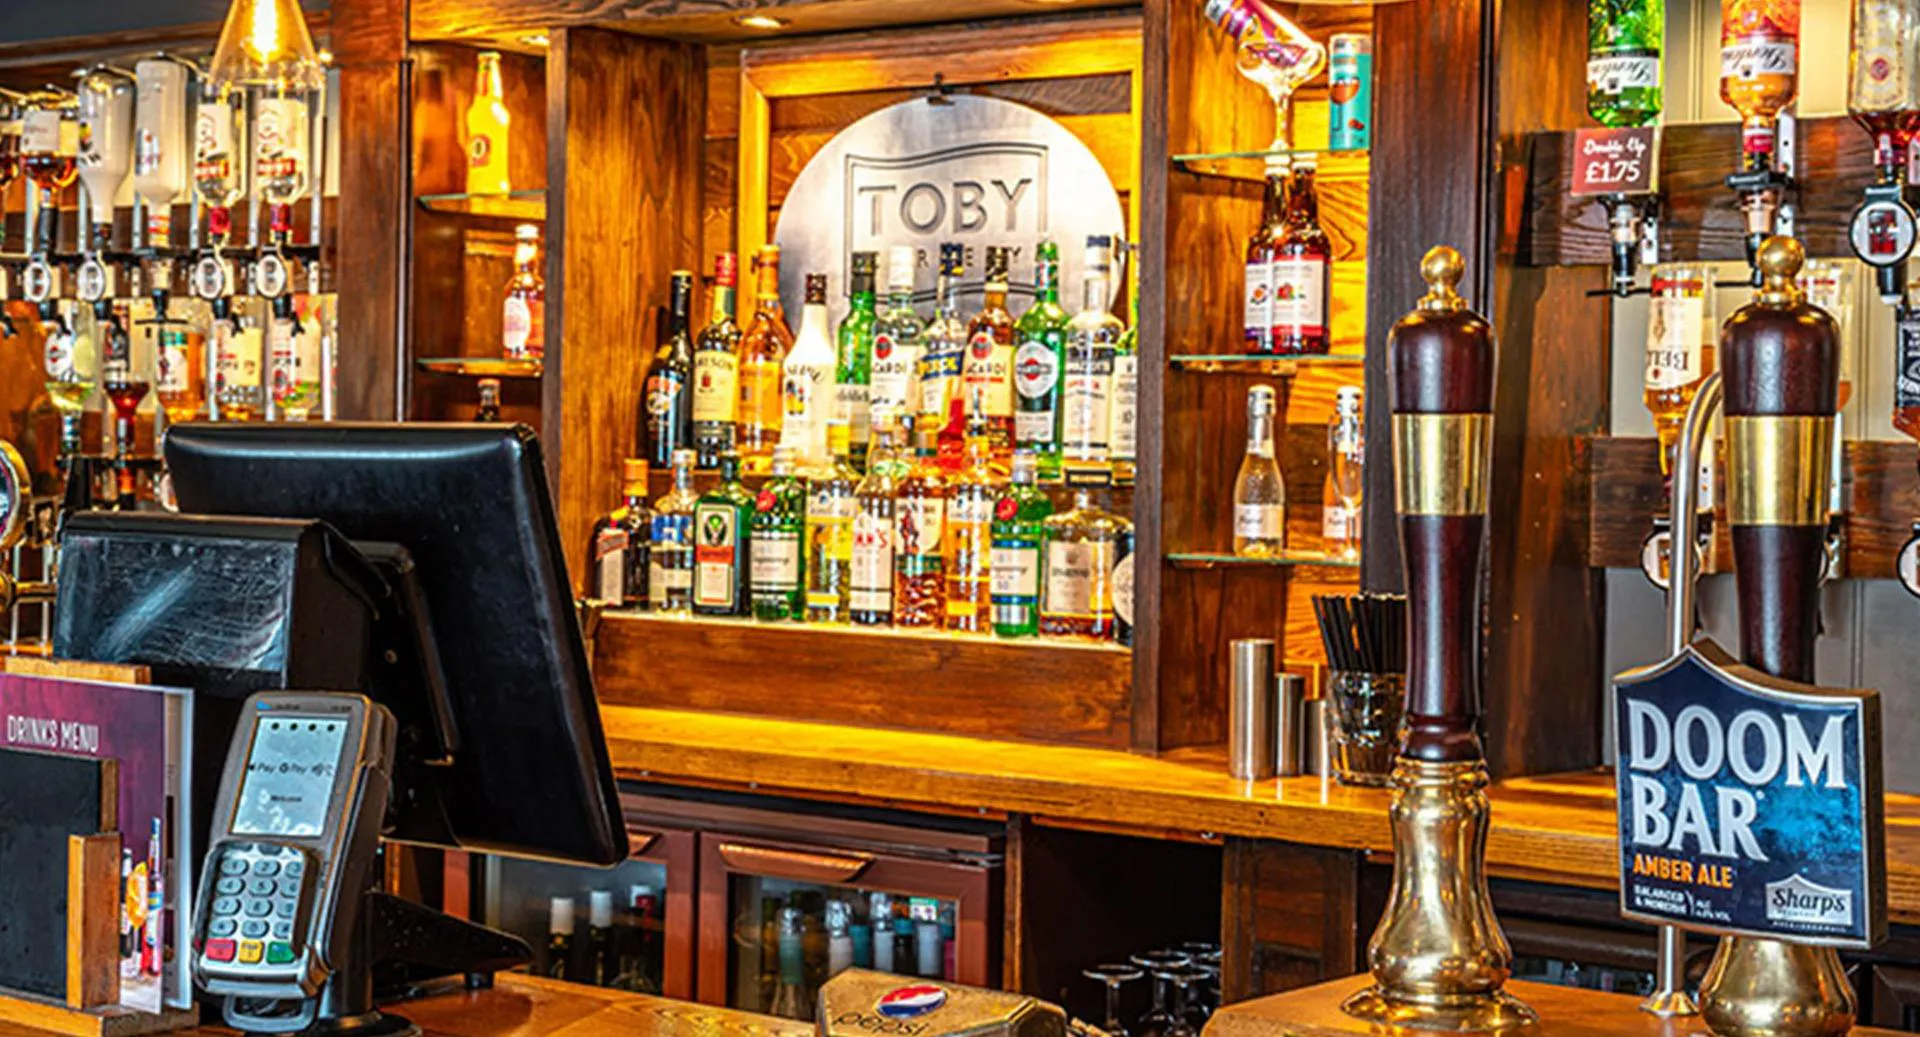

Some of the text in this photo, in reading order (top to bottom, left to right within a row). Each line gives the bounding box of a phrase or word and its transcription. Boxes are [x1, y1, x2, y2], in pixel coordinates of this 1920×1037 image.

[1583, 136, 1647, 158] Double Up
[1585, 160, 1641, 182] £1.75
[858, 177, 1033, 234] TOBY
[7, 714, 100, 753] DRINKS MENU
[1627, 699, 1848, 787] DOOM
[1630, 773, 1769, 862] BAR
[1633, 853, 1733, 889] AMBER ALE
[1773, 888, 1845, 916] Sharp's
[831, 1010, 930, 1036] pepsi
